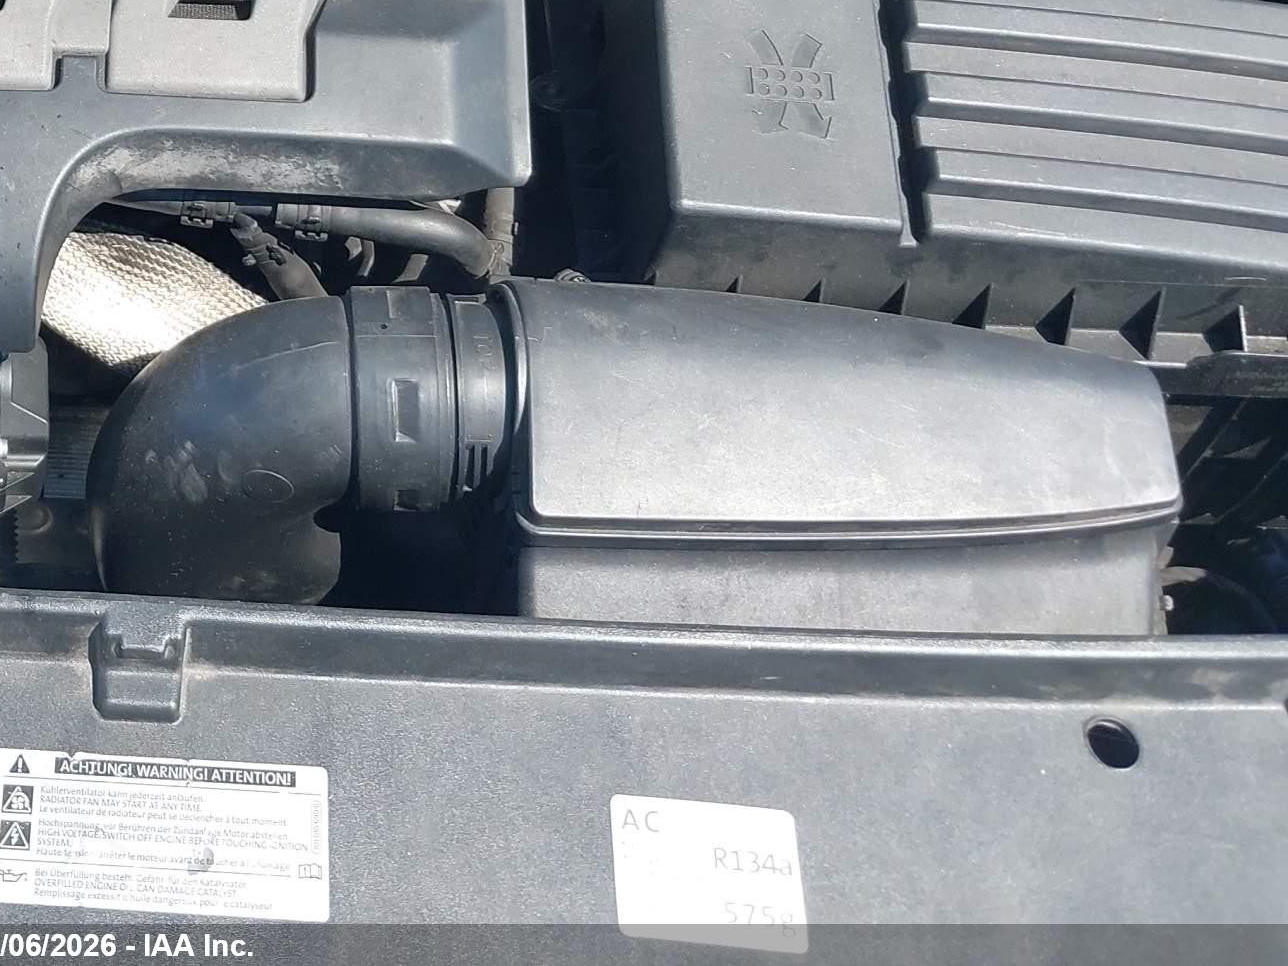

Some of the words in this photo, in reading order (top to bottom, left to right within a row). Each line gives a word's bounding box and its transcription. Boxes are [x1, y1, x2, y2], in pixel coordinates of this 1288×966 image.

[60, 760, 131, 775] ACHTUNG!
[136, 765, 207, 779] WARNING!
[211, 769, 290, 784] ATTENTION!
[713, 847, 793, 876] R134a
